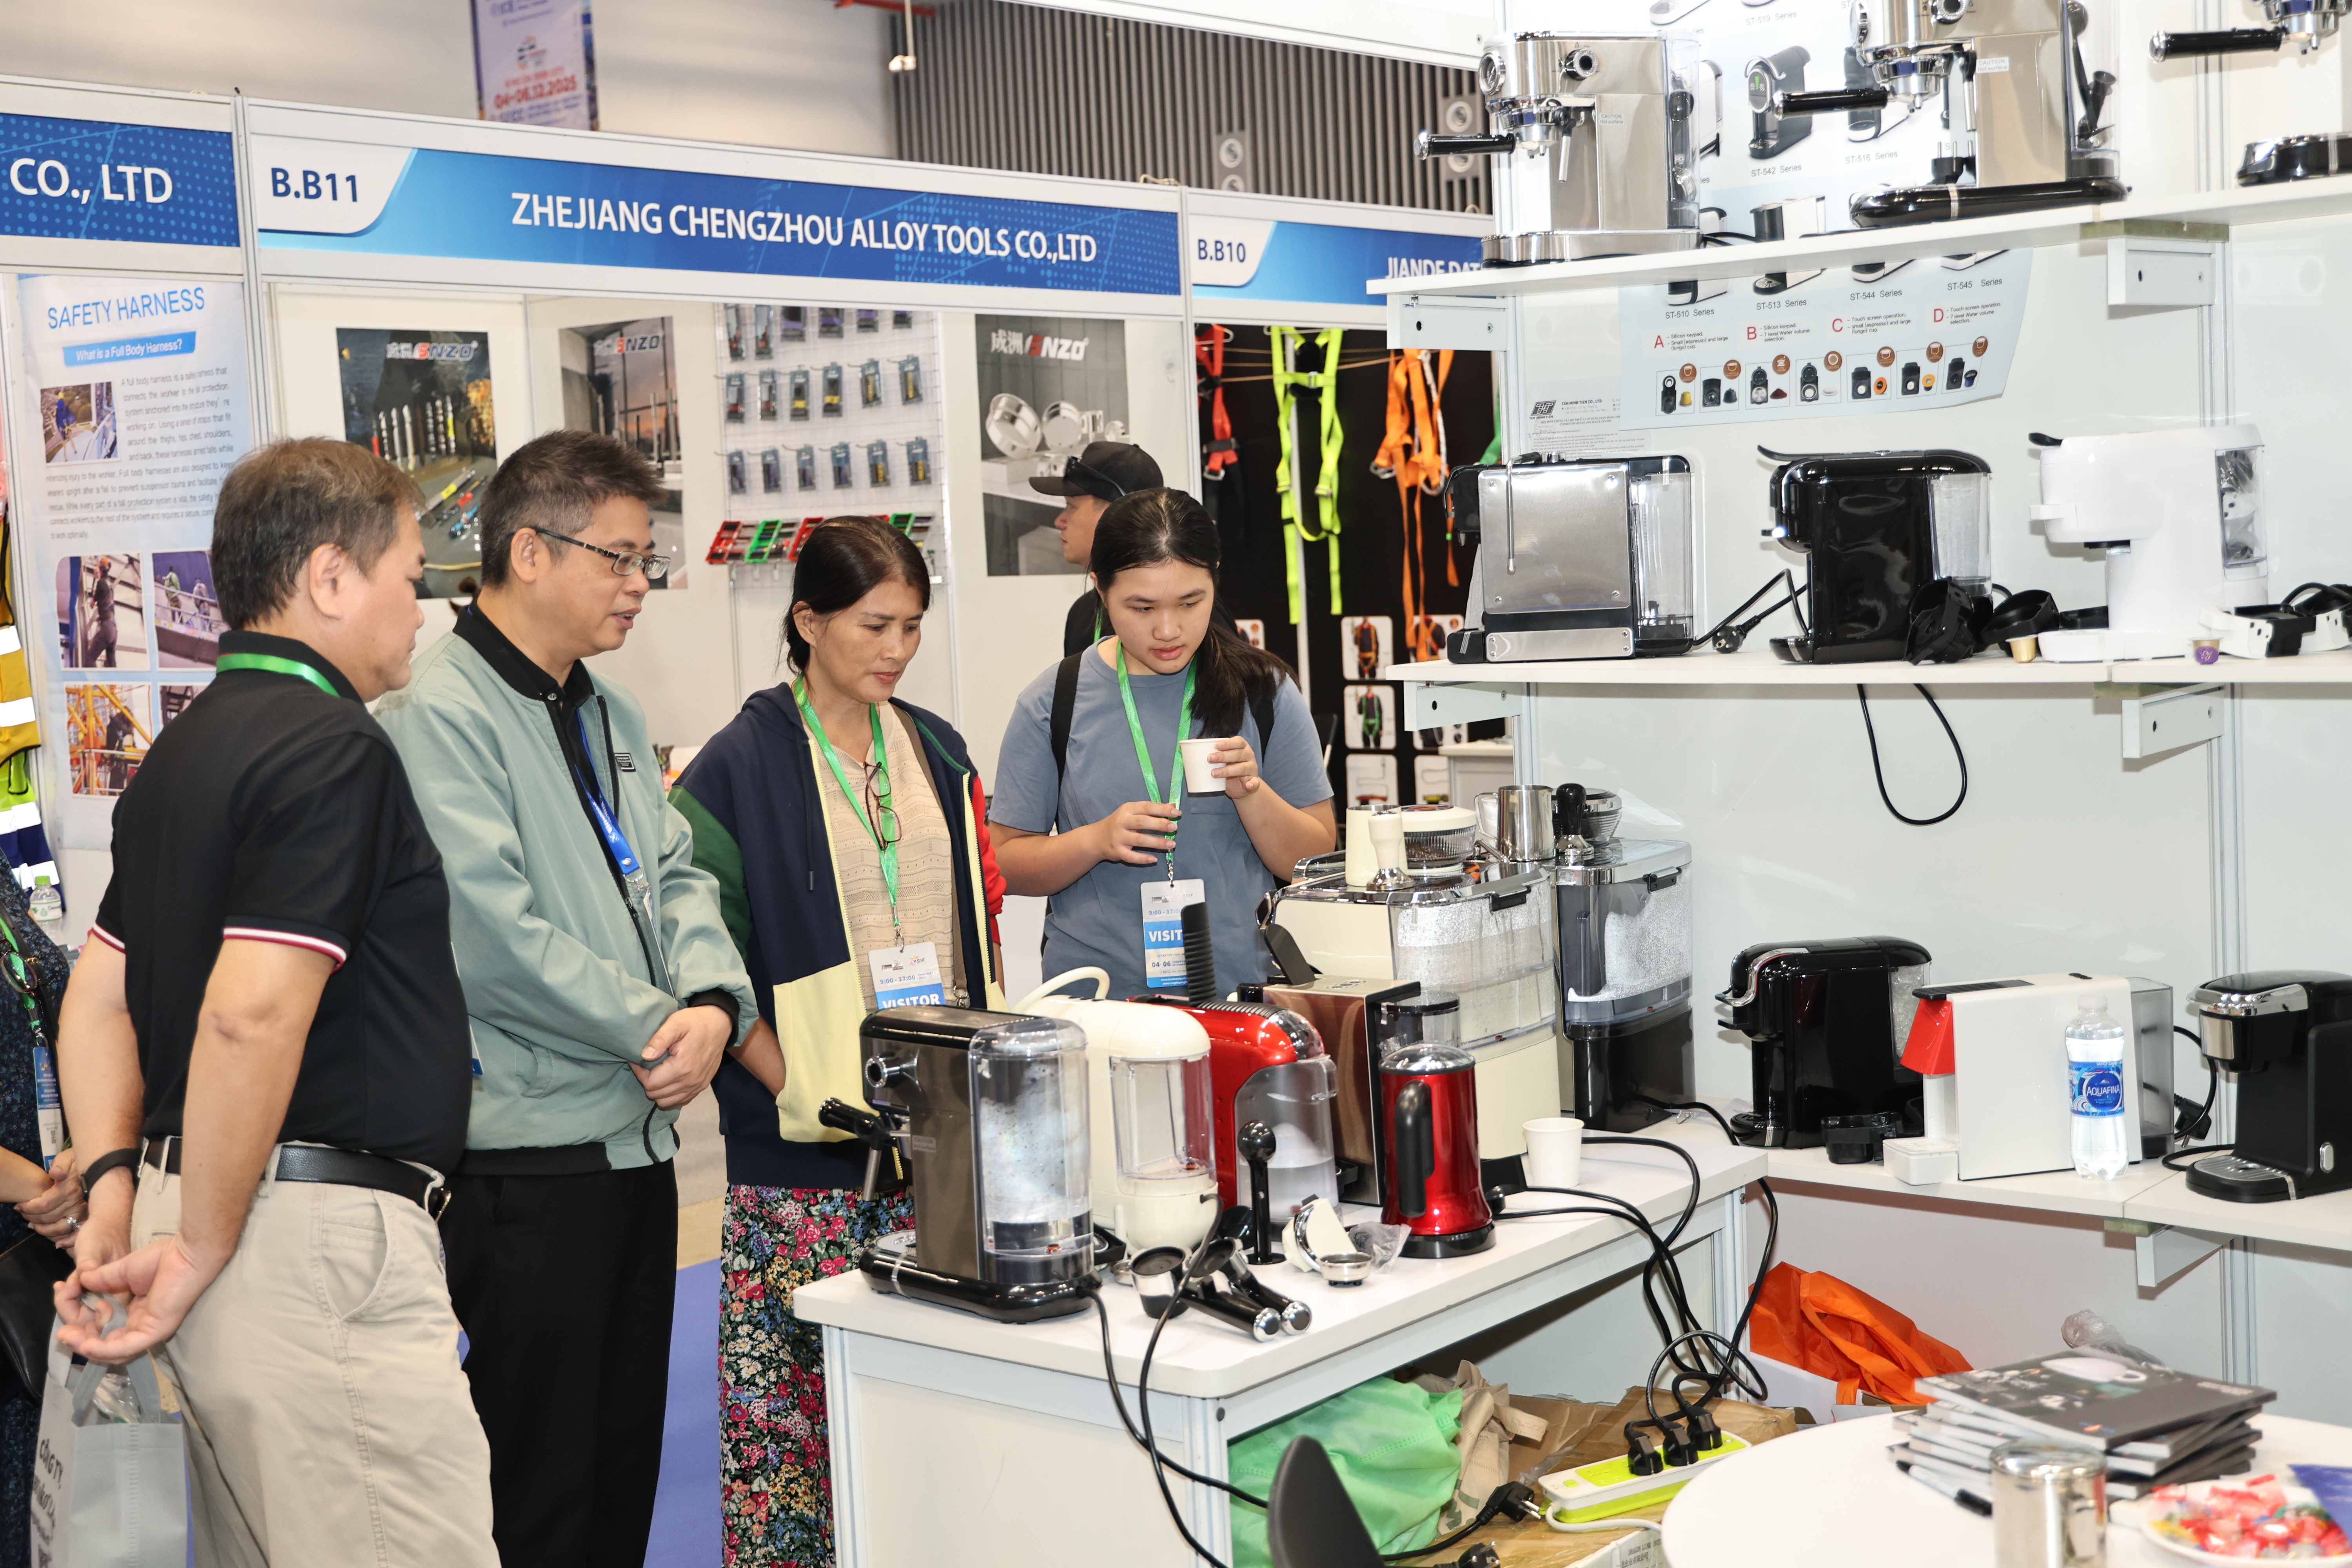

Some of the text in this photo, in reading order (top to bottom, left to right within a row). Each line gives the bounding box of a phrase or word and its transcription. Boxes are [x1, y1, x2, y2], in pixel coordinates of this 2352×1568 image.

[1746, 11, 1797, 25] ST-519 Series
[1845, 151, 1898, 164] ST-516 Series
[1751, 163, 1802, 177] ST-542 Series
[10, 158, 173, 204] CO., LTD
[271, 167, 358, 202] B.B11
[512, 192, 1096, 264] ZHEJIANG CHENGZHOU ALLOY TOOLS CO.,LTD
[1198, 238, 1246, 263] B.B10
[1947, 278, 2002, 290] ST-545 Series
[1850, 289, 1902, 301] ST-544 Series
[48, 287, 205, 329] SAFETY HARNESS
[1756, 301, 1781, 310] ST-513
[1665, 310, 1689, 319] ST-510
[1933, 308, 1944, 323] D
[1832, 318, 1843, 332] C
[1747, 327, 1757, 340] B
[1654, 335, 1664, 348] A
[76, 338, 183, 361] What is a Full Body Harness?
[1148, 929, 1183, 942] VISIT
[882, 993, 940, 1009] VISITOR
[2086, 1084, 2120, 1096] AQUAFINA
